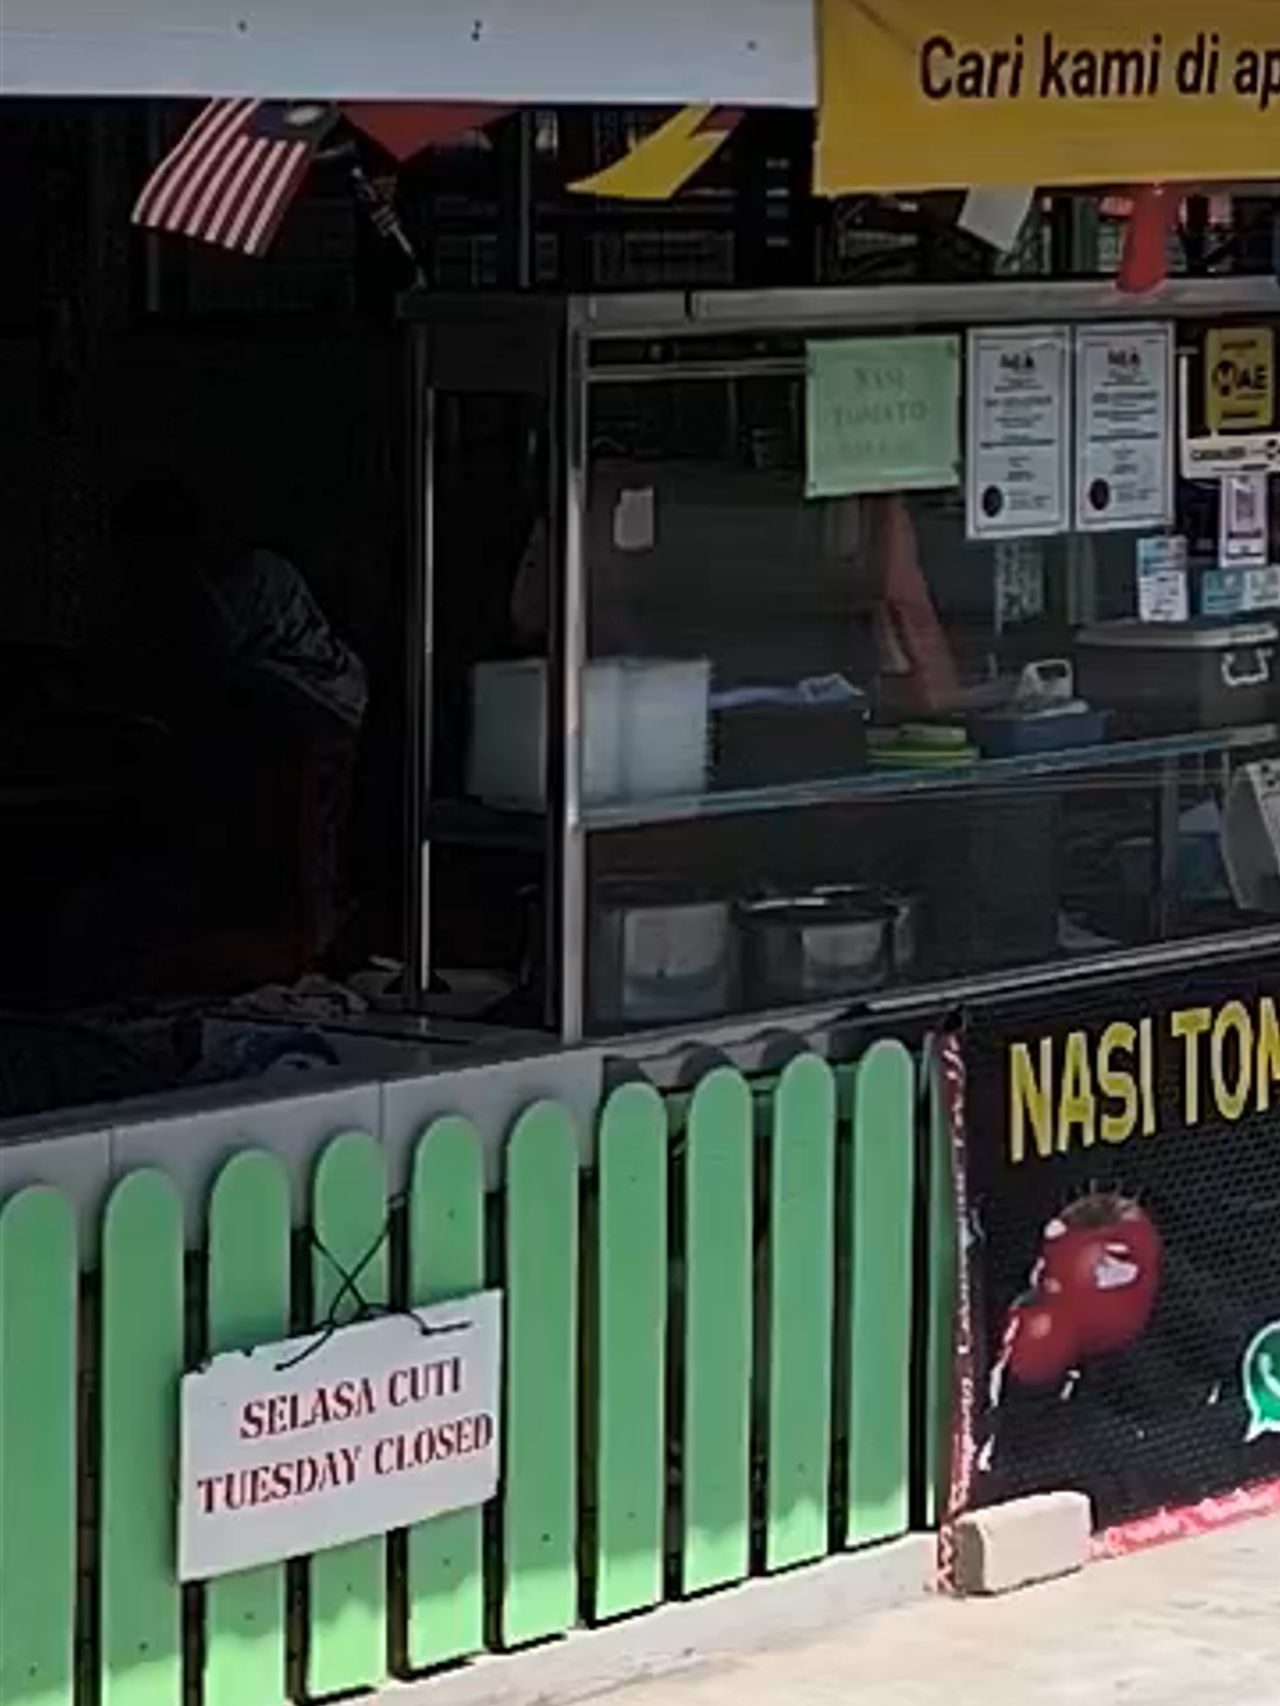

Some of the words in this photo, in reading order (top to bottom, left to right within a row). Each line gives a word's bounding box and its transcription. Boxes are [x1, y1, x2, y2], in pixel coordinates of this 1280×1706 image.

[918, 33, 1025, 100] Cari
[1039, 32, 1161, 99] kami
[1174, 32, 1220, 95] di
[1006, 1020, 1157, 1163] NASI
[239, 1376, 376, 1440] SELASA
[387, 1356, 461, 1408] CUTI
[196, 1444, 361, 1515] TUESDAY
[373, 1412, 494, 1477] CLOSED
